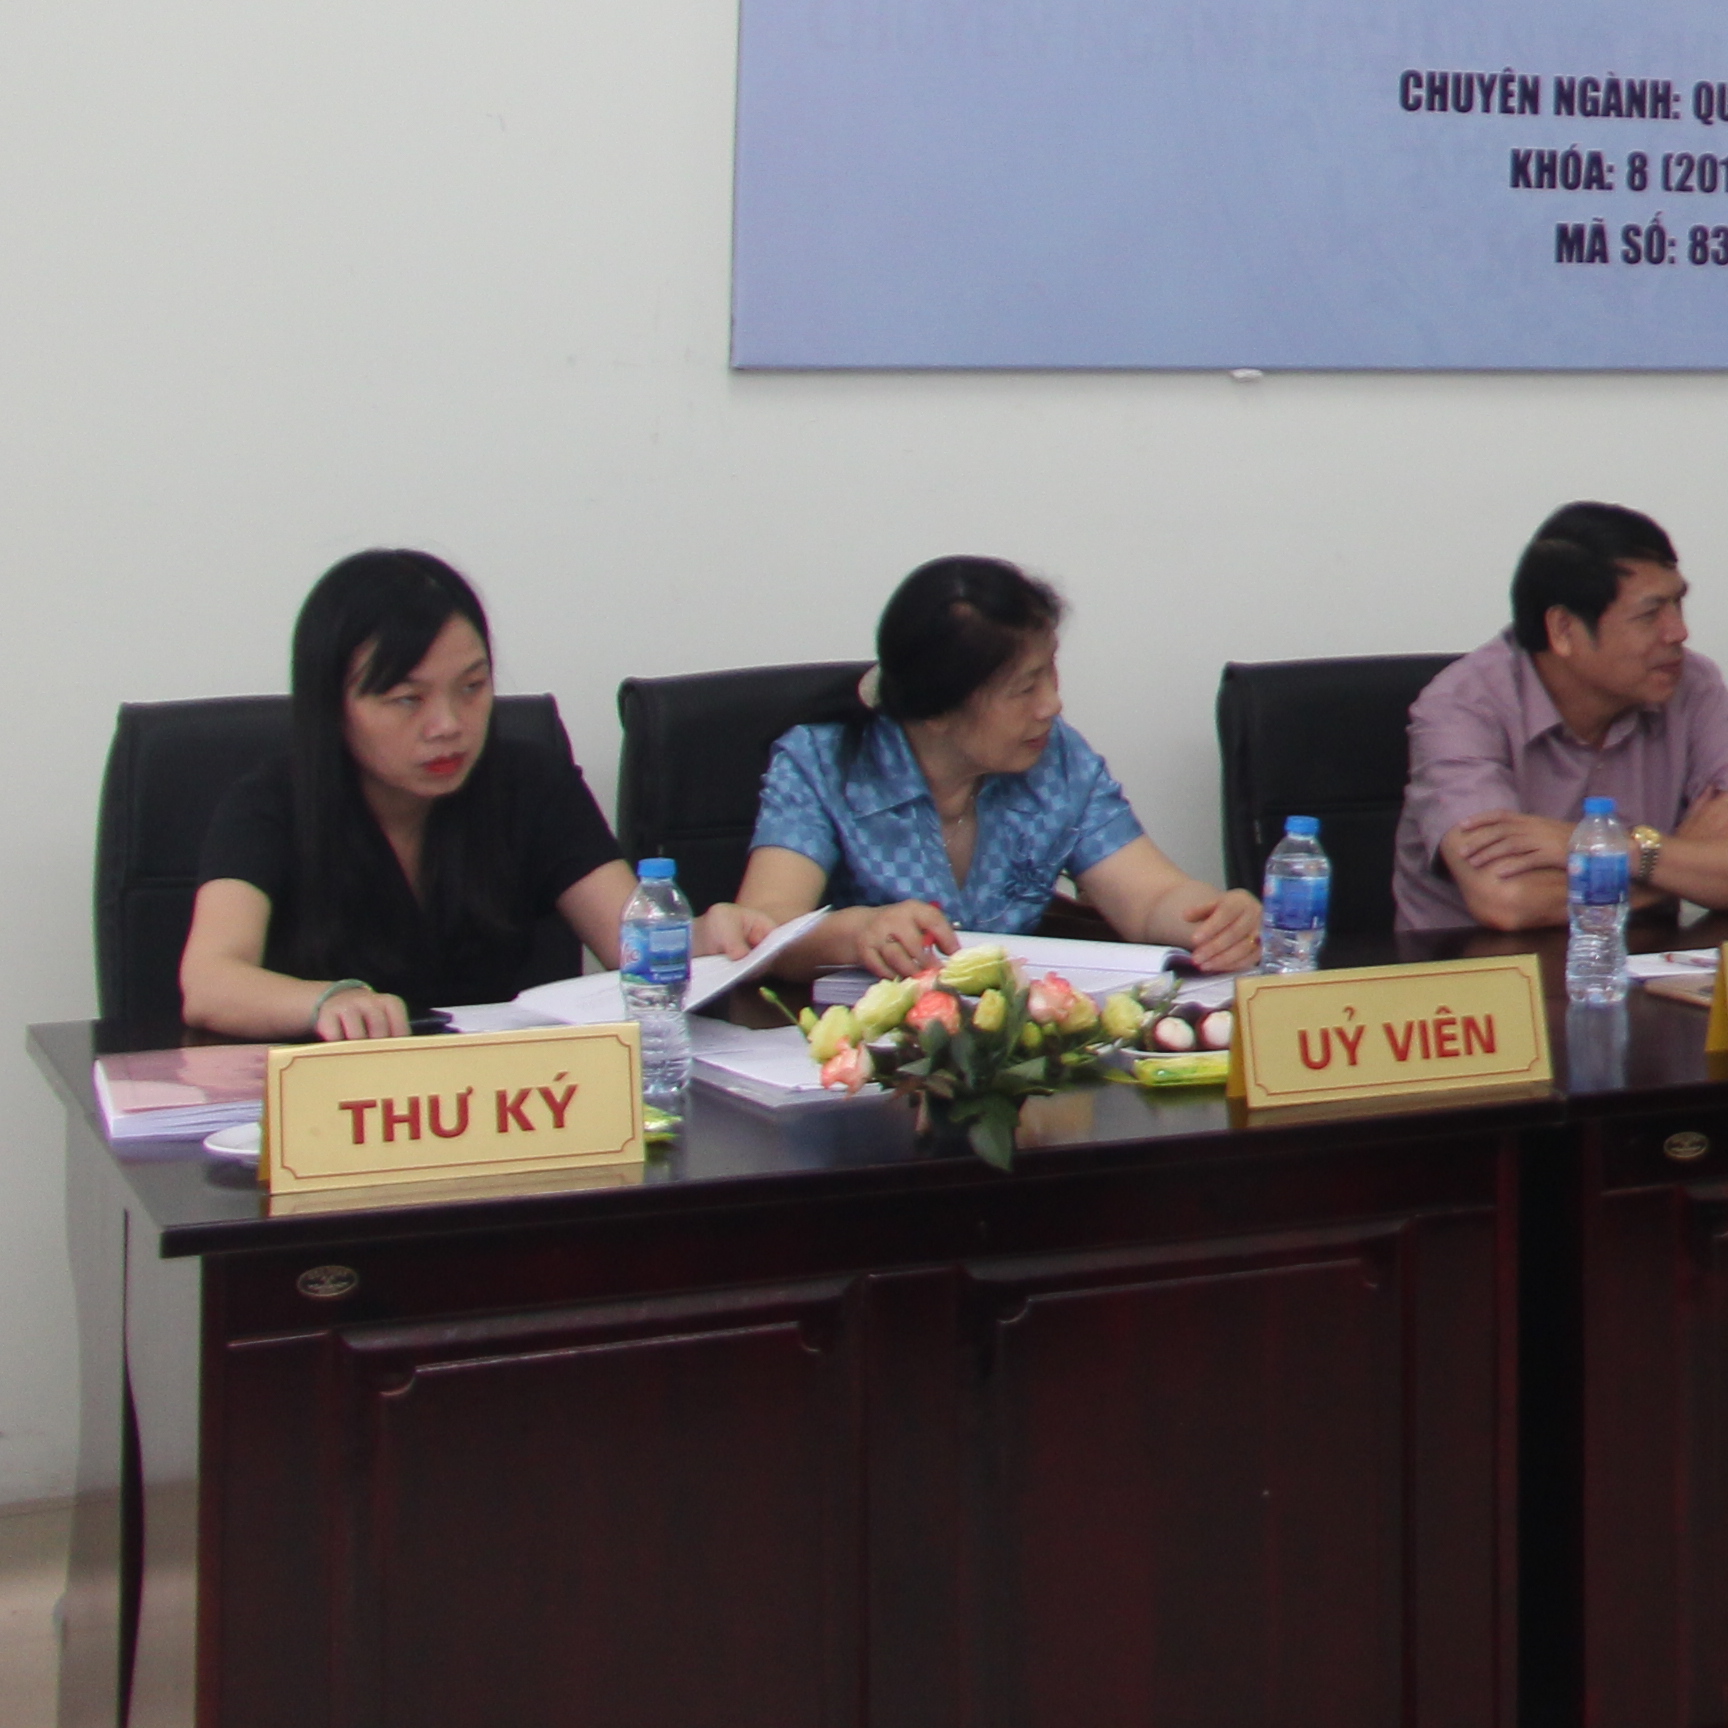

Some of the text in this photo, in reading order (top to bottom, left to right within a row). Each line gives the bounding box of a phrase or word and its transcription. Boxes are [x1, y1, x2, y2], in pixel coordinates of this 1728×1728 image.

[1400, 66, 1540, 116] CHUYÊN
[1553, 71, 1680, 120] NGÀNH:
[1510, 143, 1614, 191] KHÓA:
[1627, 152, 1648, 192] 8
[1555, 217, 1609, 264] MÃ
[1621, 211, 1676, 266] SỐ:
[1382, 1005, 1498, 1063] VIÊN
[339, 1071, 578, 1145] THƯ KÝ
